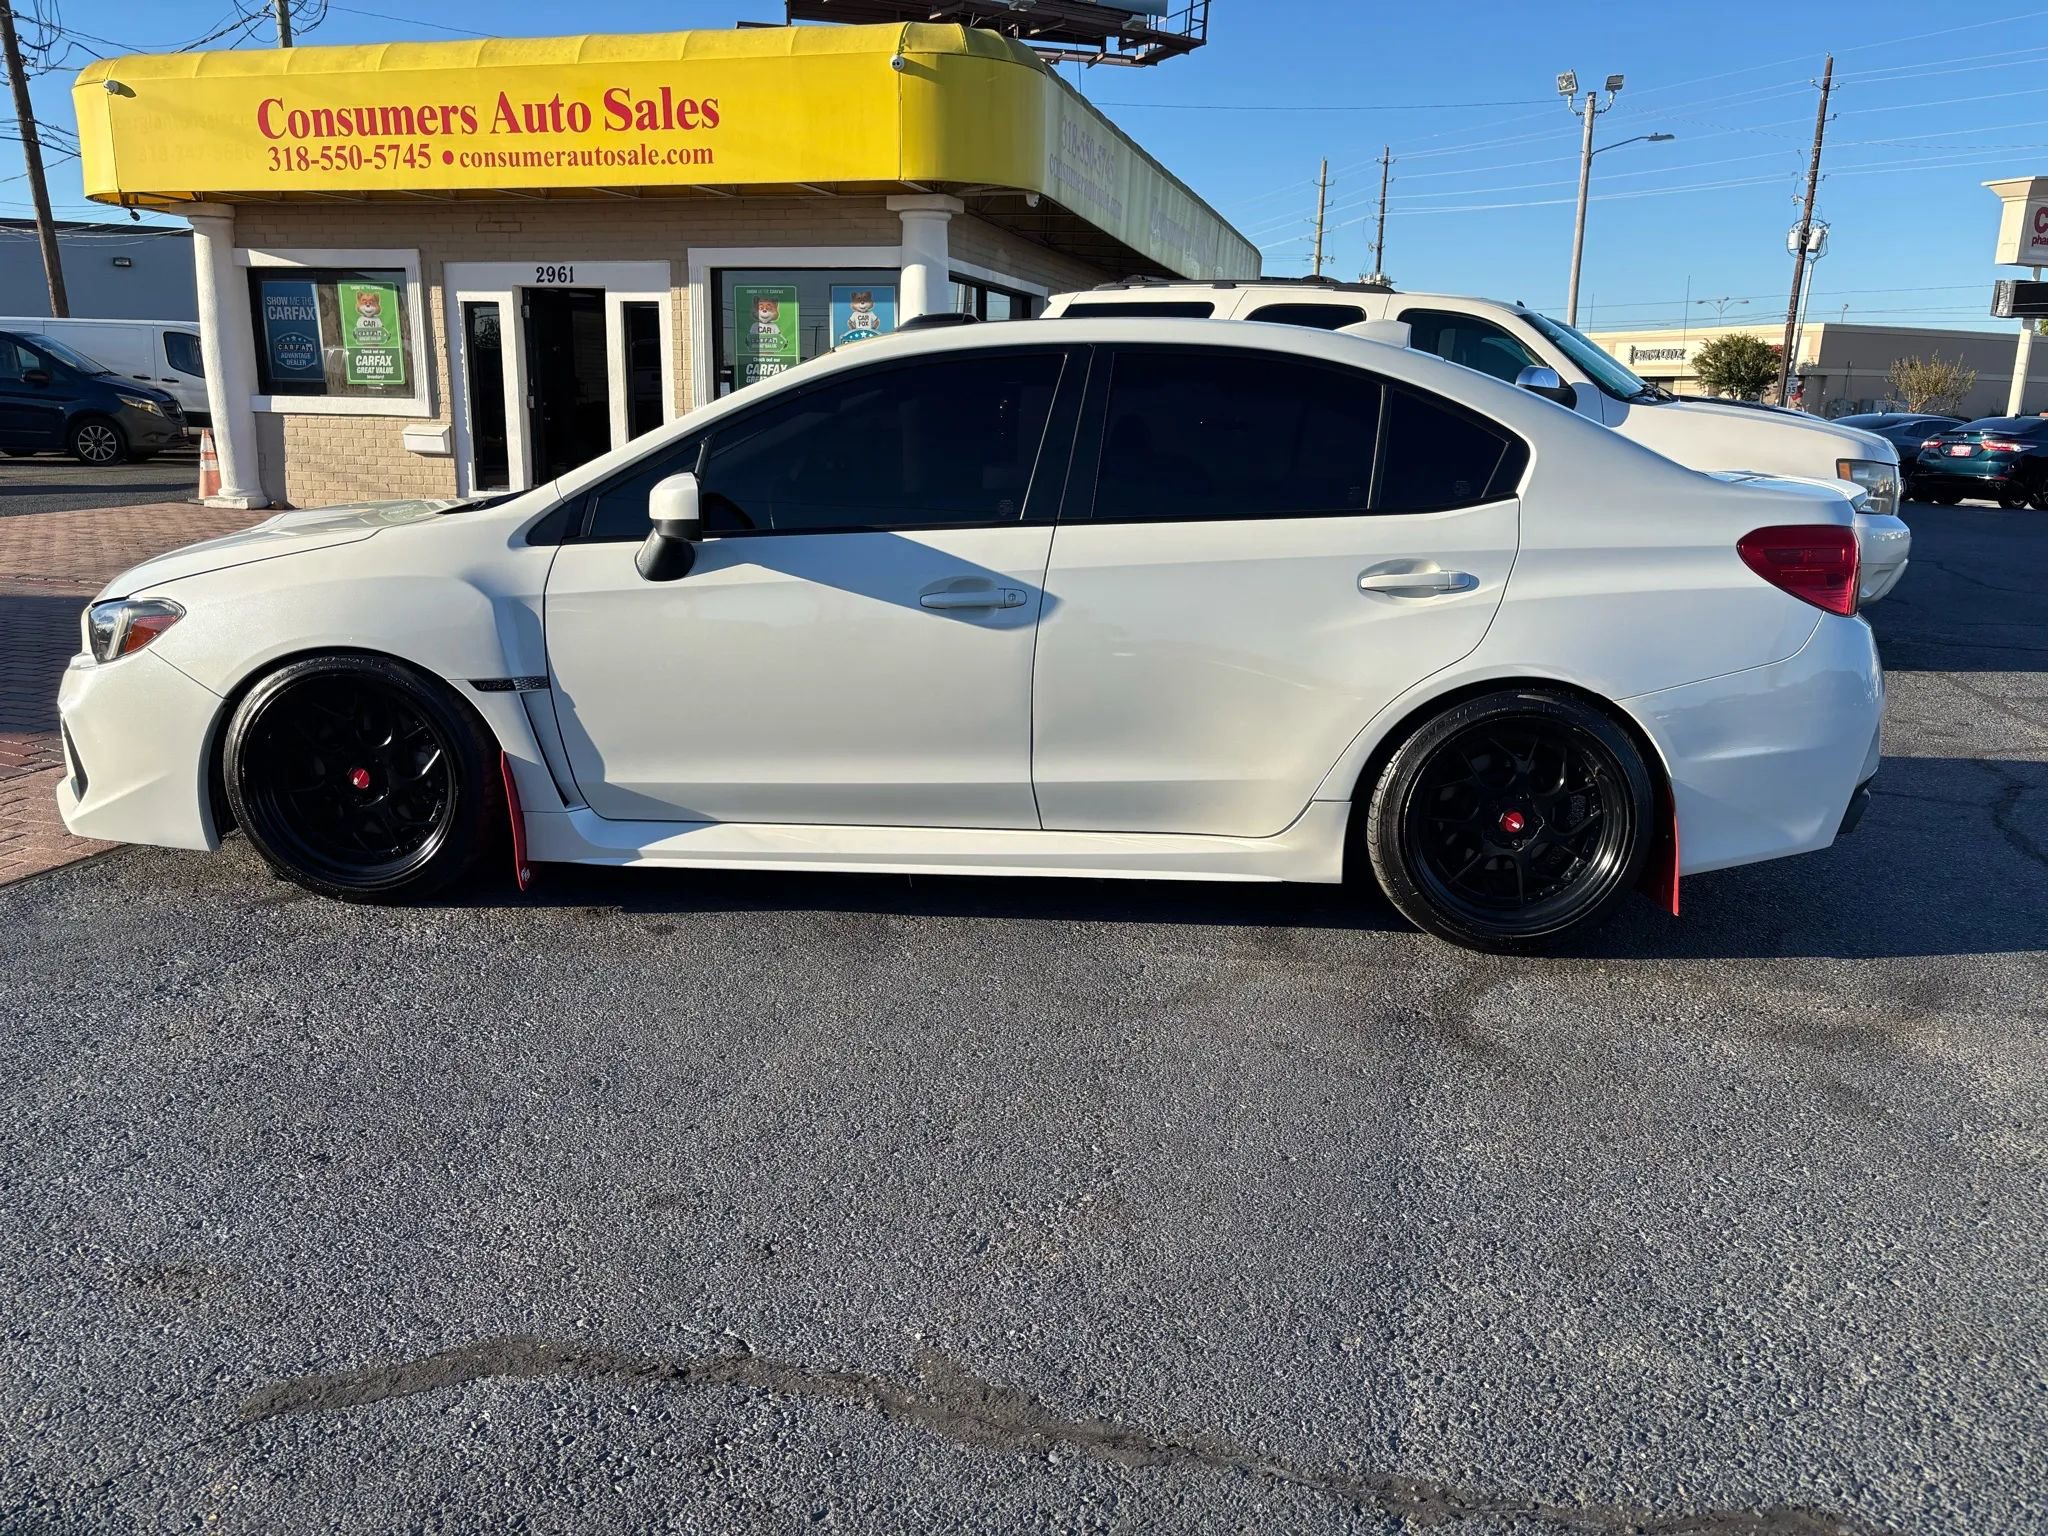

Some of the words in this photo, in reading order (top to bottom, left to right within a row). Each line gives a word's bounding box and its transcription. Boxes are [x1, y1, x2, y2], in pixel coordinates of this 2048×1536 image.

[257, 97, 478, 140] Consumers
[489, 91, 592, 135] Auto
[603, 86, 720, 132] Sales
[268, 143, 432, 172] 318-550-5745
[459, 143, 714, 169] consumerautosale.com
[536, 265, 574, 283] 2961
[266, 296, 288, 305] SHOW
[268, 306, 316, 321] CARFAX
[363, 320, 376, 328] CAR
[758, 326, 772, 334] CAR
[278, 343, 313, 352] CARFAX
[355, 355, 393, 366] CARFAX
[356, 366, 375, 374] GREAT
[375, 366, 394, 374] VALUE
[1786, 386, 1796, 394] 35
